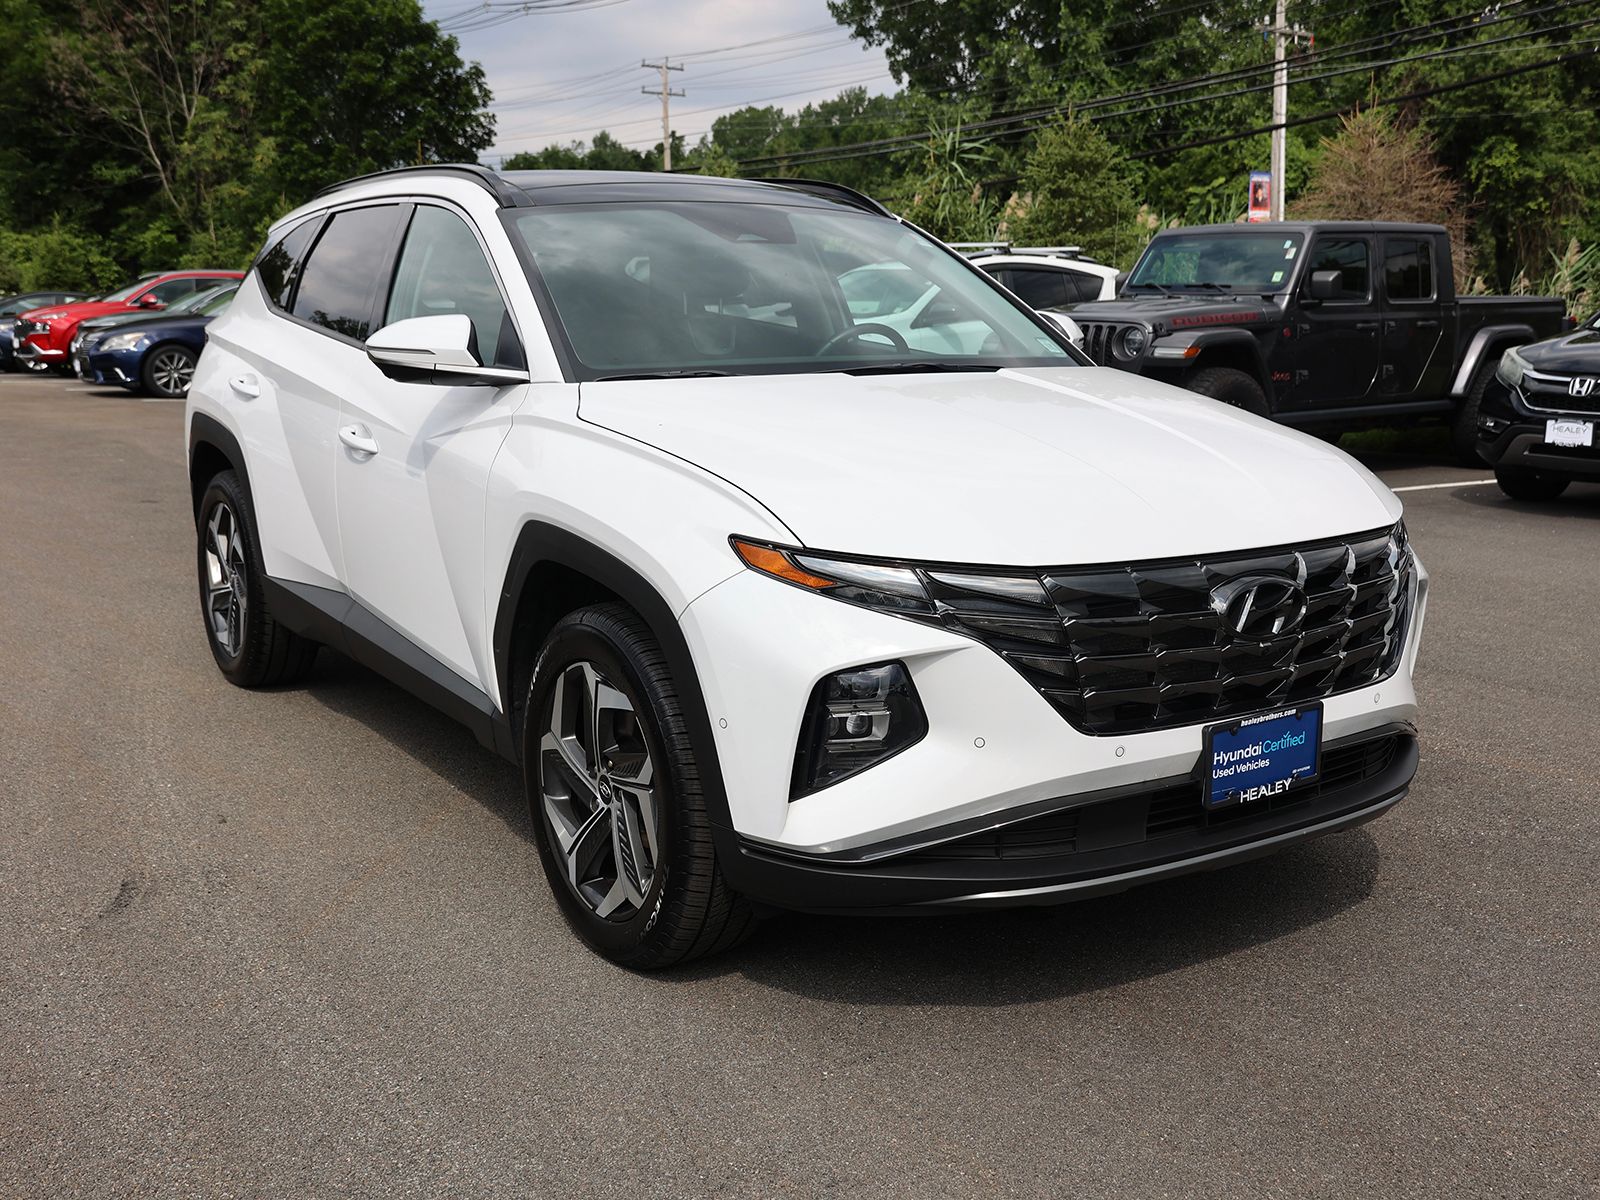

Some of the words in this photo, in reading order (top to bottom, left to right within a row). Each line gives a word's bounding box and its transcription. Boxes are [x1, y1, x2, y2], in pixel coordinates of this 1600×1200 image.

[1552, 425, 1588, 434] HEALEY
[1240, 709, 1297, 727] healeybrothers.com
[1213, 741, 1262, 766] Hyundai
[1262, 731, 1306, 753] Certified
[1212, 765, 1235, 779] Used
[1235, 758, 1270, 773] Vehicles
[1240, 777, 1293, 803] HEALEY
